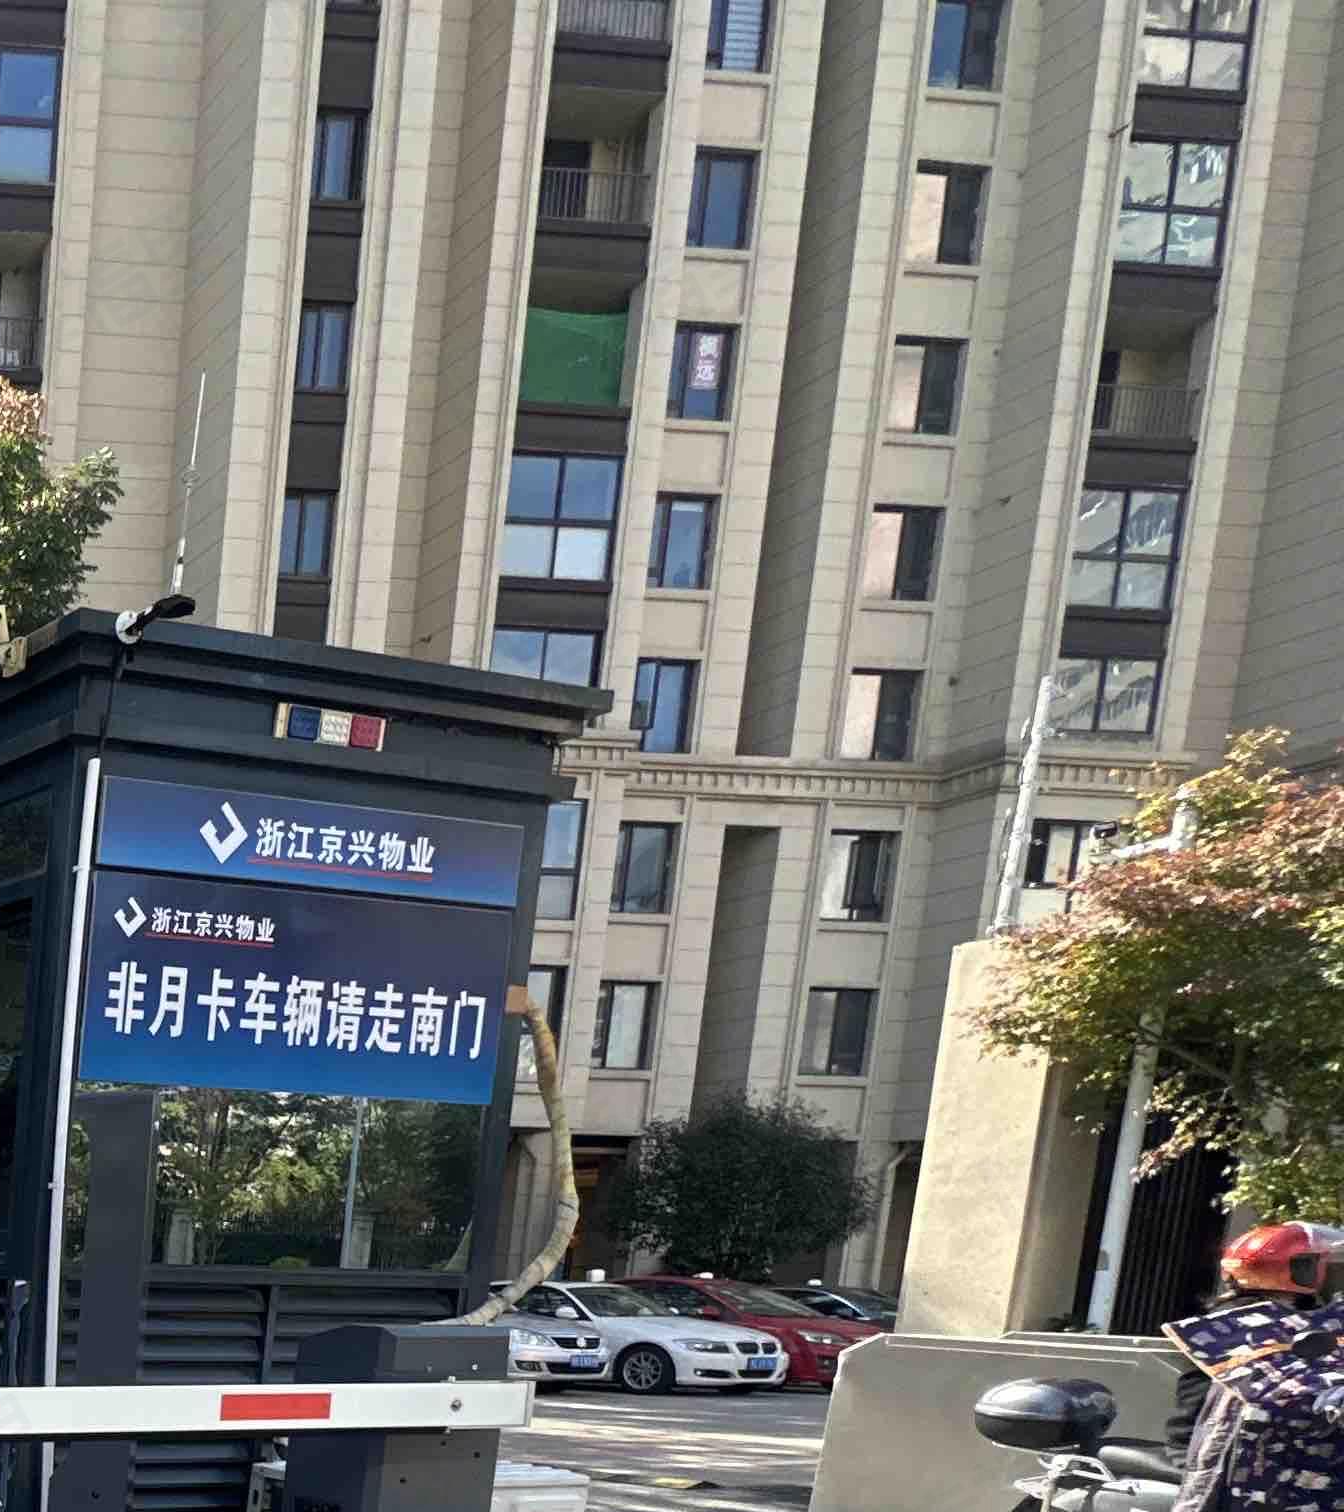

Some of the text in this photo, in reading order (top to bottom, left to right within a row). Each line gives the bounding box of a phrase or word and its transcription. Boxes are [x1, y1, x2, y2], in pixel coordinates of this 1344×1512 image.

[255, 818, 434, 873] 浙江京兴物业
[151, 907, 275, 943] 浙江京兴物业
[104, 961, 485, 1059] 非月卡车辆请走南门
